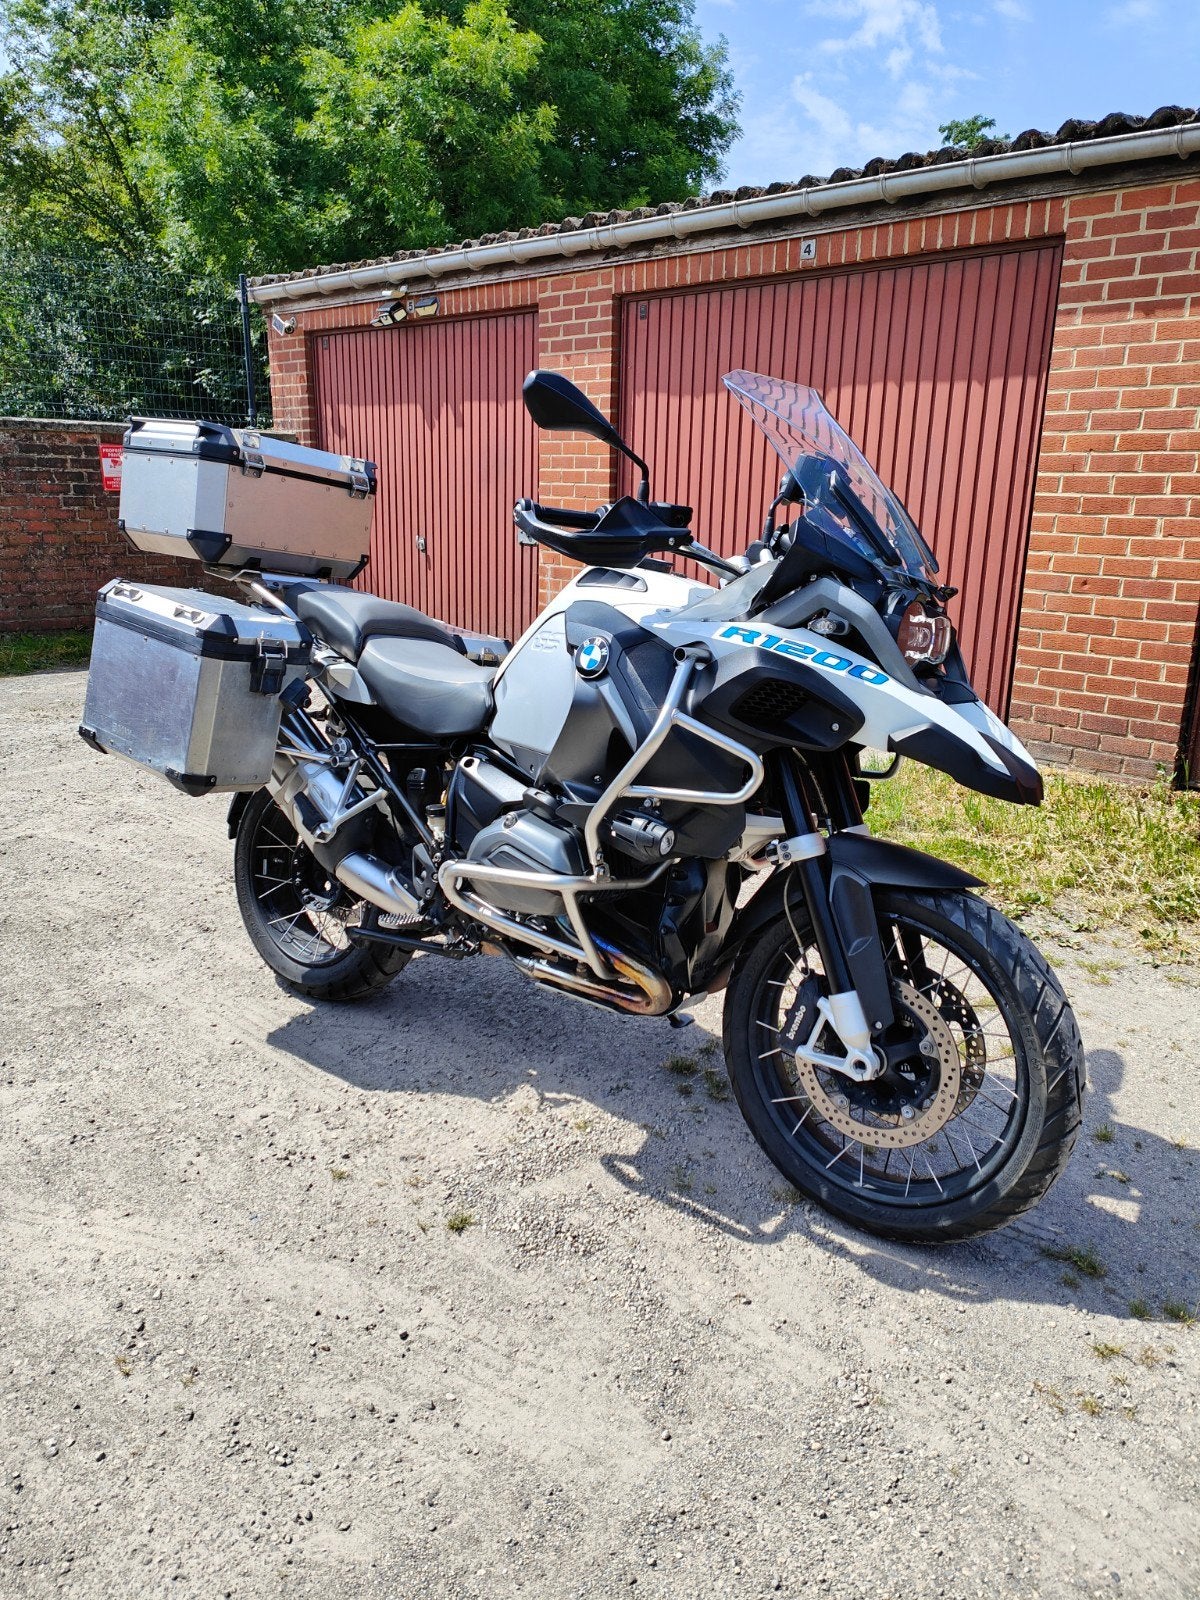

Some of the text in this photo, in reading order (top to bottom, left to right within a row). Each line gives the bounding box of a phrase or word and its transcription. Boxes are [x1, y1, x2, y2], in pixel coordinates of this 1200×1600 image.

[804, 244, 811, 256] 4
[719, 626, 890, 685] R1200
[786, 1005, 806, 1040] brembo
